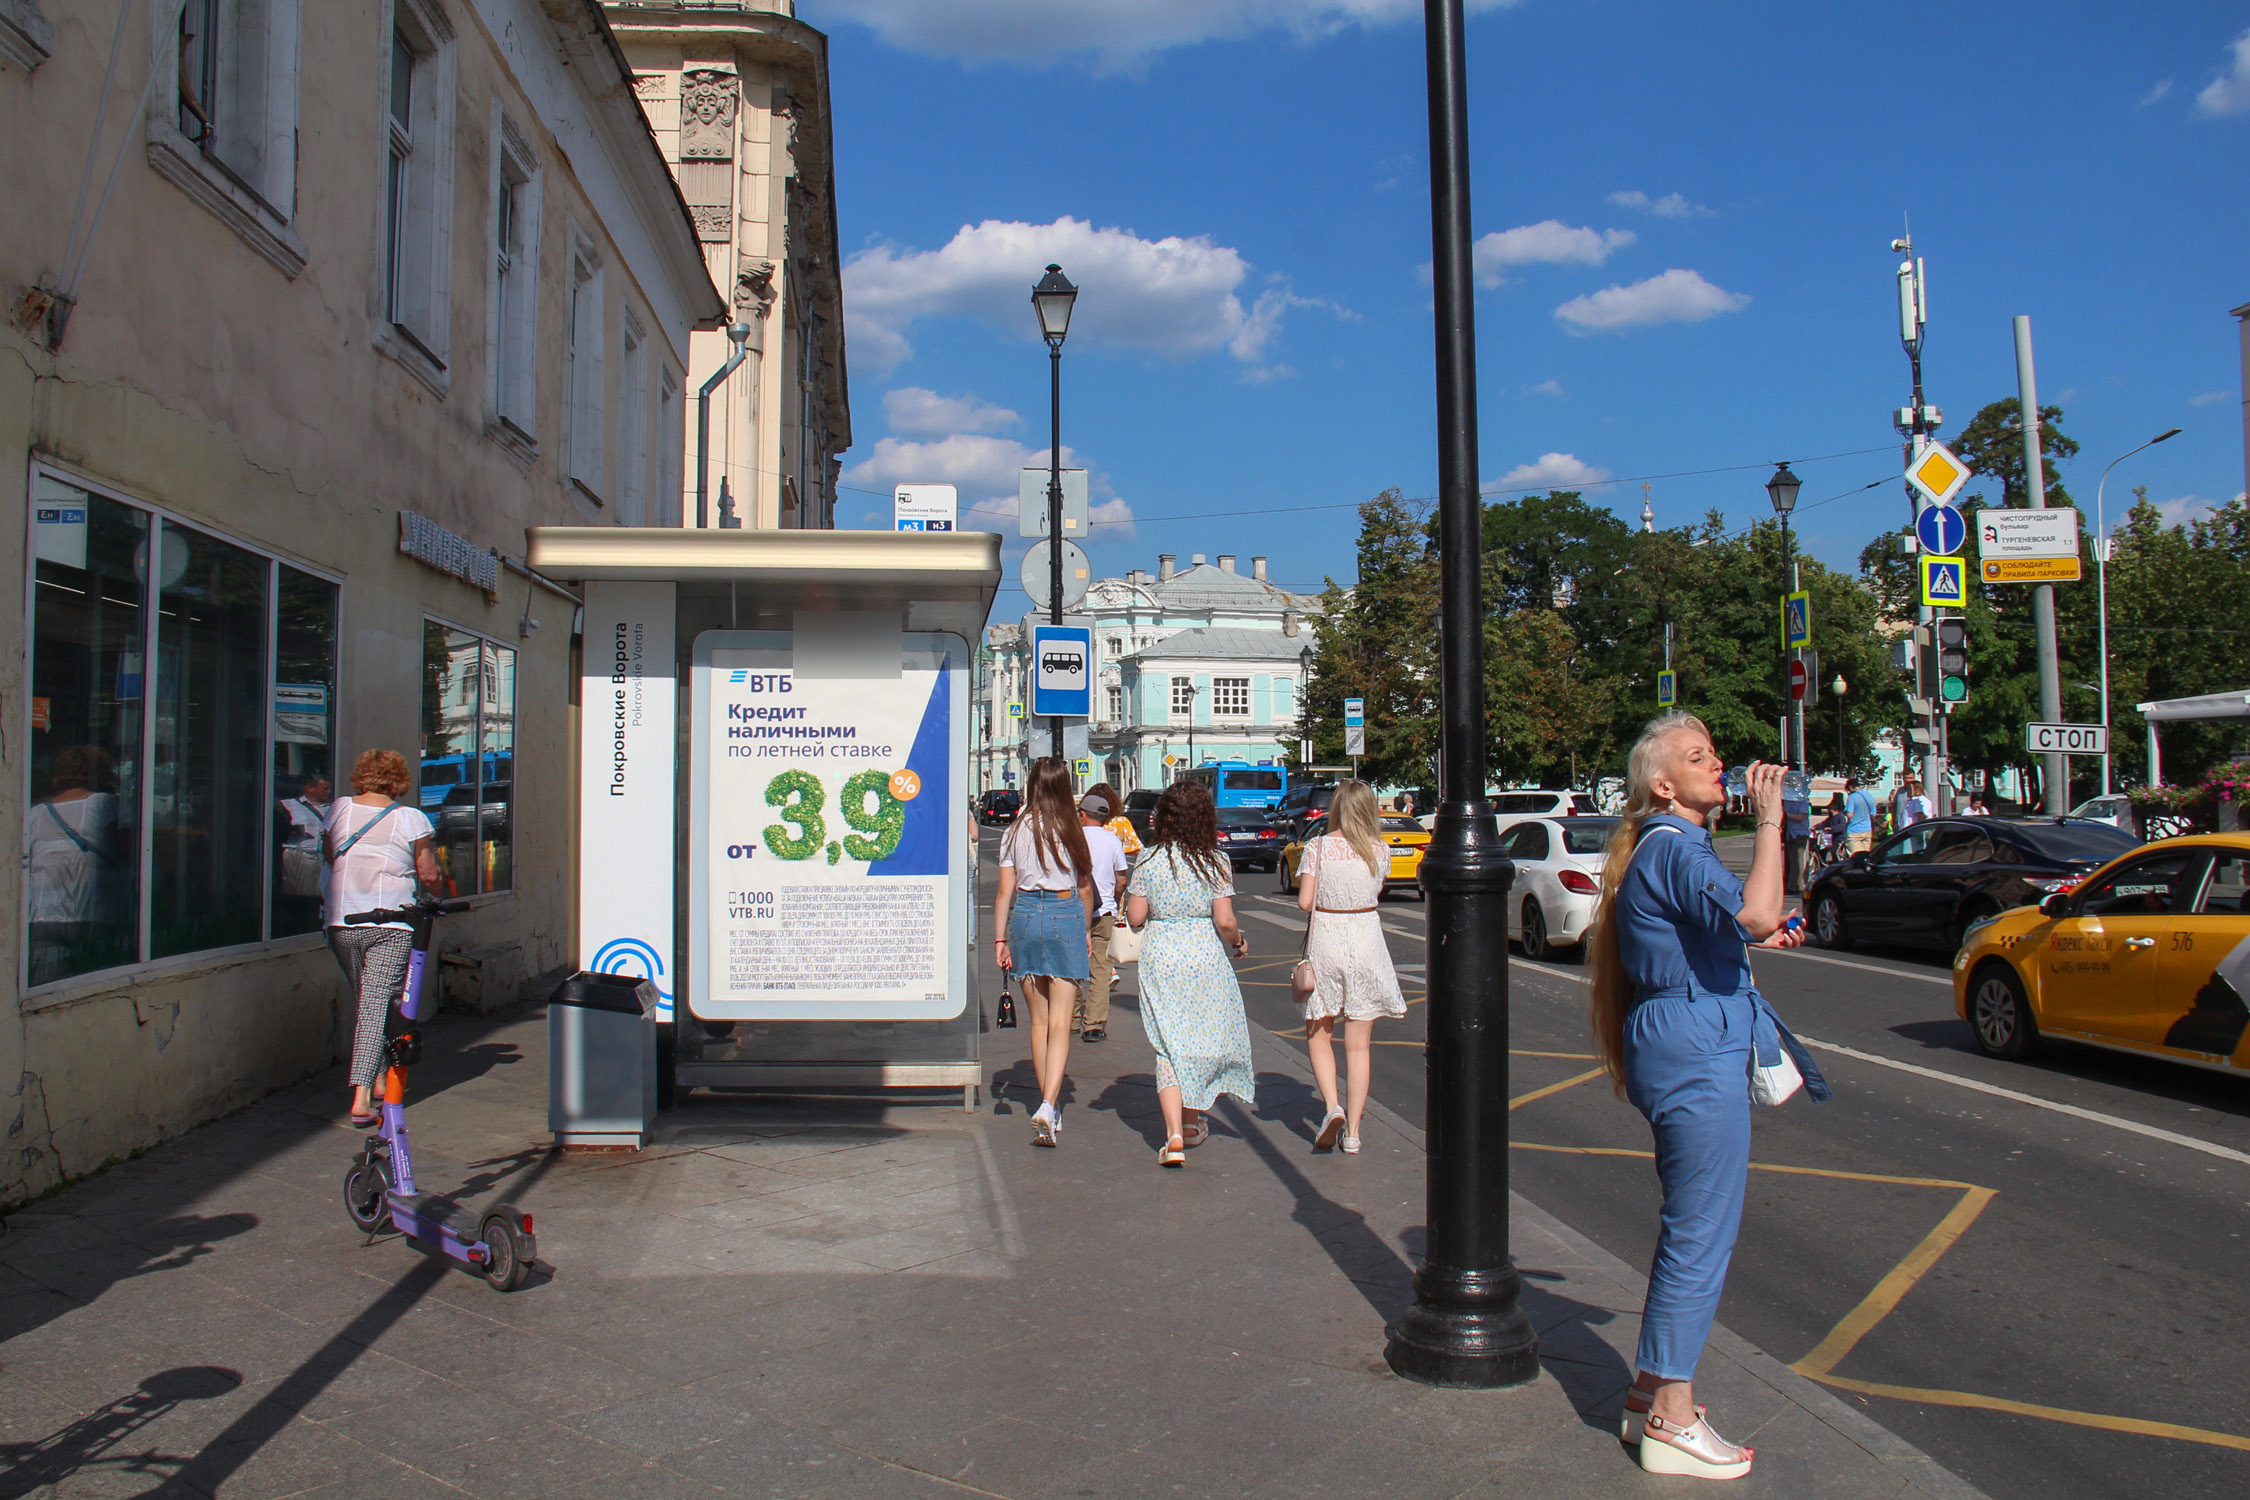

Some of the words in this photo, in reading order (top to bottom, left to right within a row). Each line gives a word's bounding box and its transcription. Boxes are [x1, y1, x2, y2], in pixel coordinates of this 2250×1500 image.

[2000, 514, 2058, 522] ЧИСТОПРУДНЫЙ
[2000, 523, 2029, 531] бульвар
[2001, 535, 2056, 543] ТУРГЕНЕВСКАЯ
[2002, 561, 2052, 569] СОБЛЮДАЙТЕ
[2003, 570, 2036, 578] ПРАВИЛА
[2037, 569, 2077, 577] ПАРКОВКИ!
[632, 623, 643, 661] Vorota
[612, 622, 629, 684] Ворота
[750, 675, 793, 693] ВТБ
[632, 664, 643, 727] Pokrovskie
[728, 703, 808, 723] Кредит
[728, 726, 856, 739] наличными
[2038, 728, 2097, 749] СТОП
[610, 689, 628, 796] Покровские
[728, 744, 752, 758] по
[756, 741, 825, 758] летней
[830, 744, 893, 758] ставке
[726, 844, 757, 860] от
[738, 891, 775, 905] 1000
[728, 907, 775, 919] VTB.RU
[2050, 932, 2083, 952] Яндекс
[2086, 931, 2113, 952] Такси
[2170, 931, 2194, 951] 576
